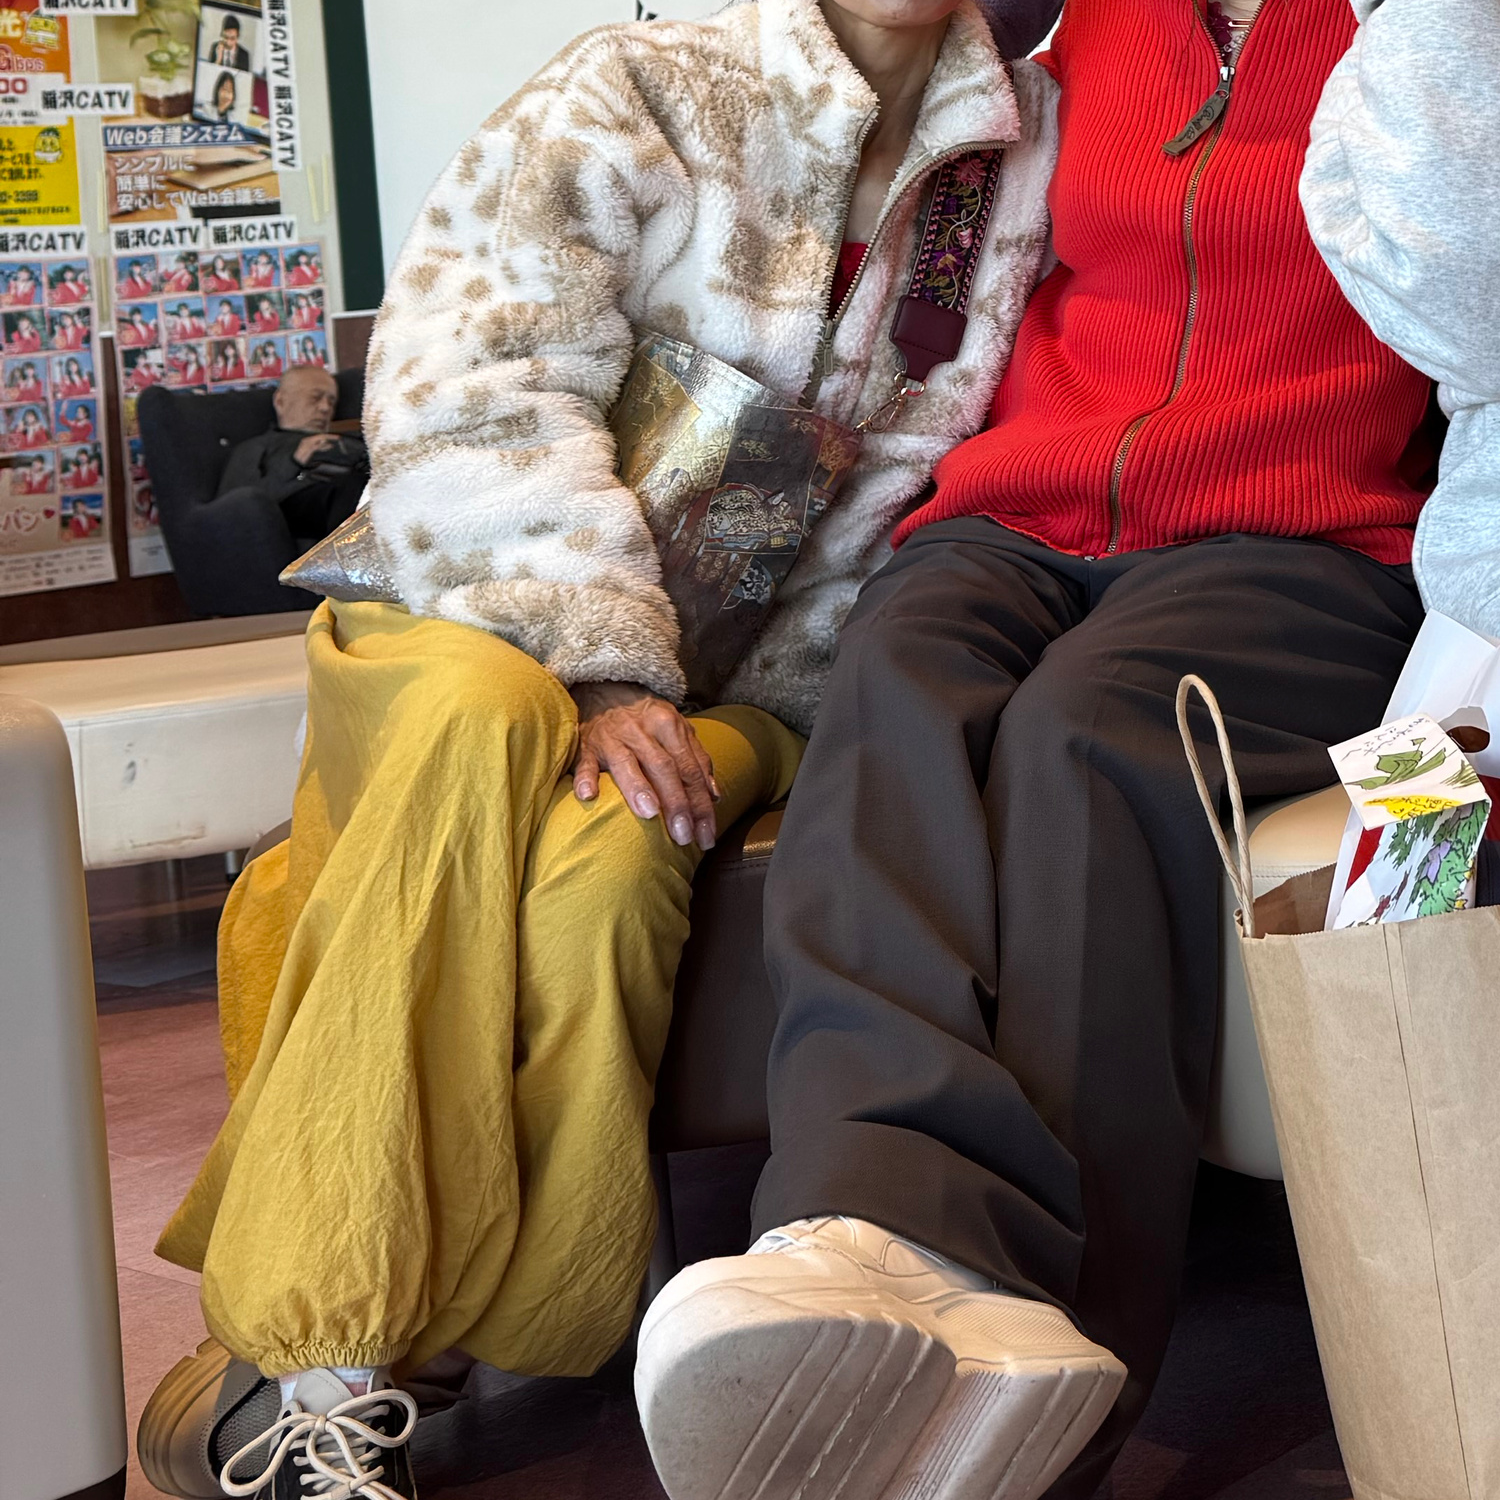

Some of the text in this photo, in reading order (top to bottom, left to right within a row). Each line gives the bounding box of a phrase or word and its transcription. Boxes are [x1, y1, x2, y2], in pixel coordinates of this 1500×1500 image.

[106, 125, 245, 146] Web会議システム
